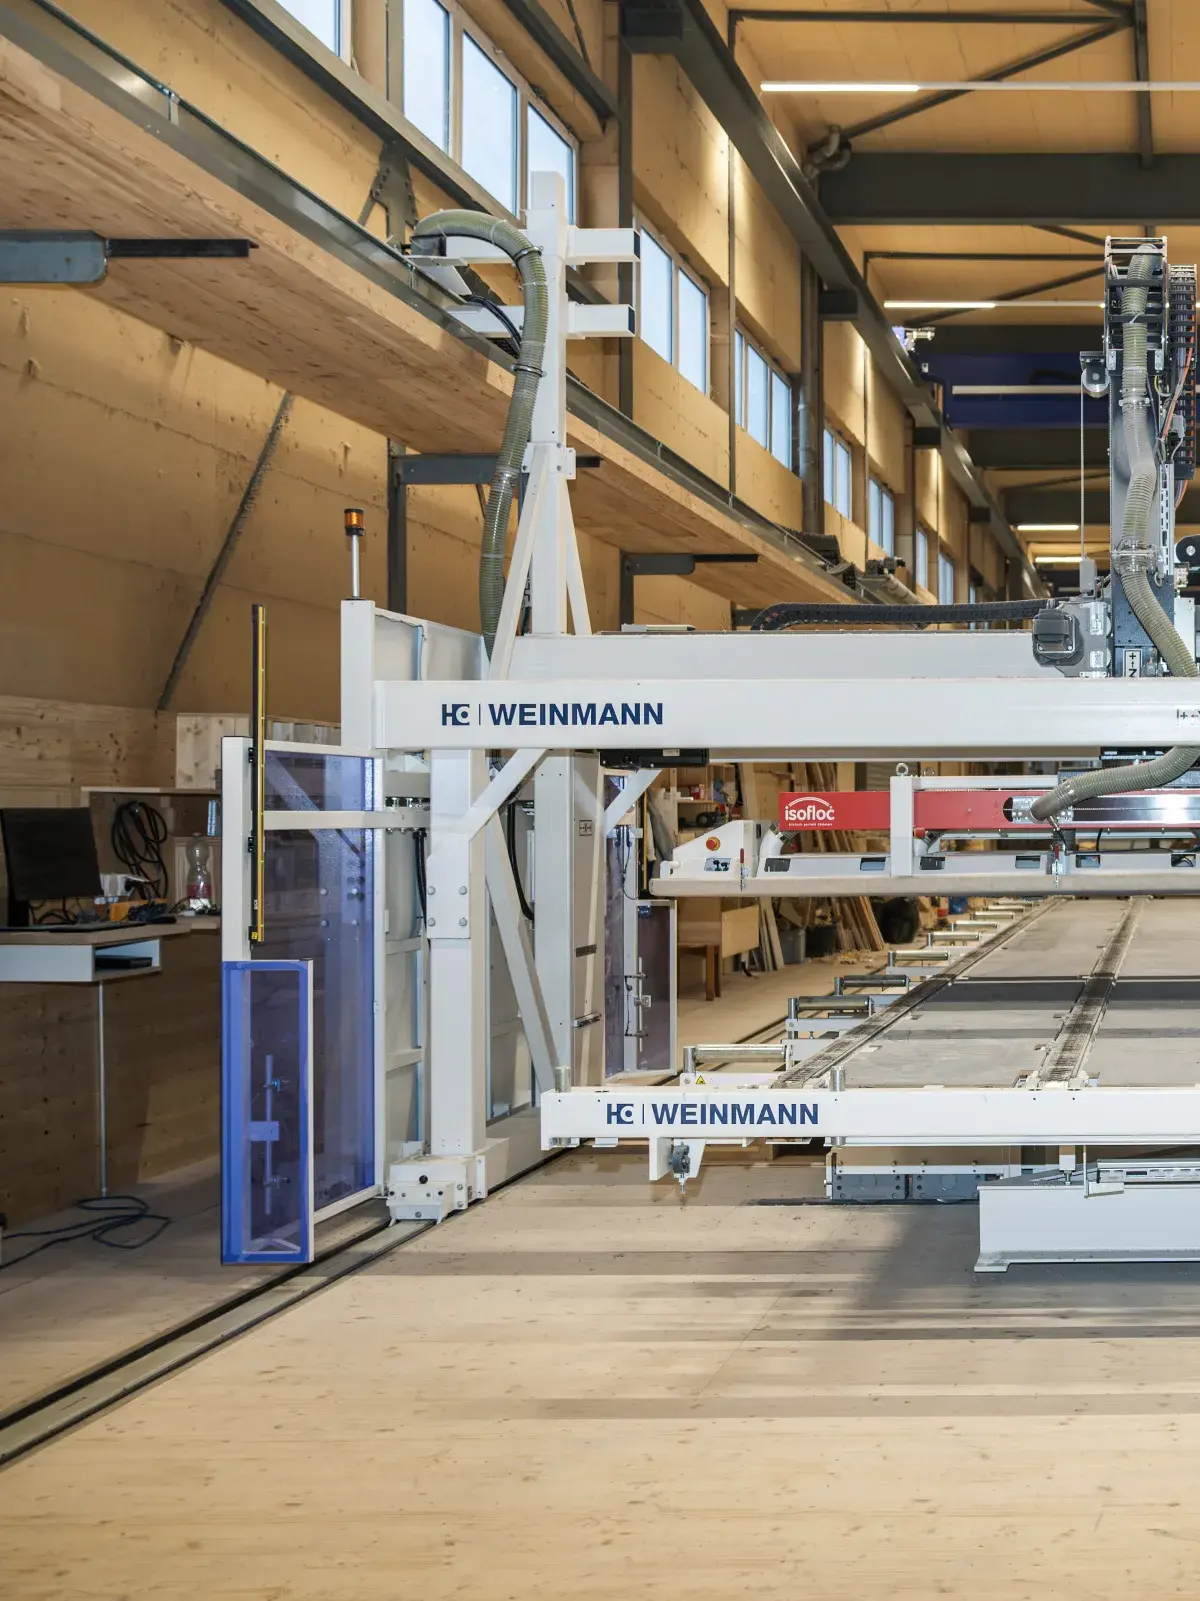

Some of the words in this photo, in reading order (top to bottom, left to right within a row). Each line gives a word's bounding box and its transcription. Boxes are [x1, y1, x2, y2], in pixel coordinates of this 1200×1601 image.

[488, 703, 664, 726] WEINMANN
[784, 804, 835, 821] isofloc
[651, 1103, 819, 1125] WEINMANN
